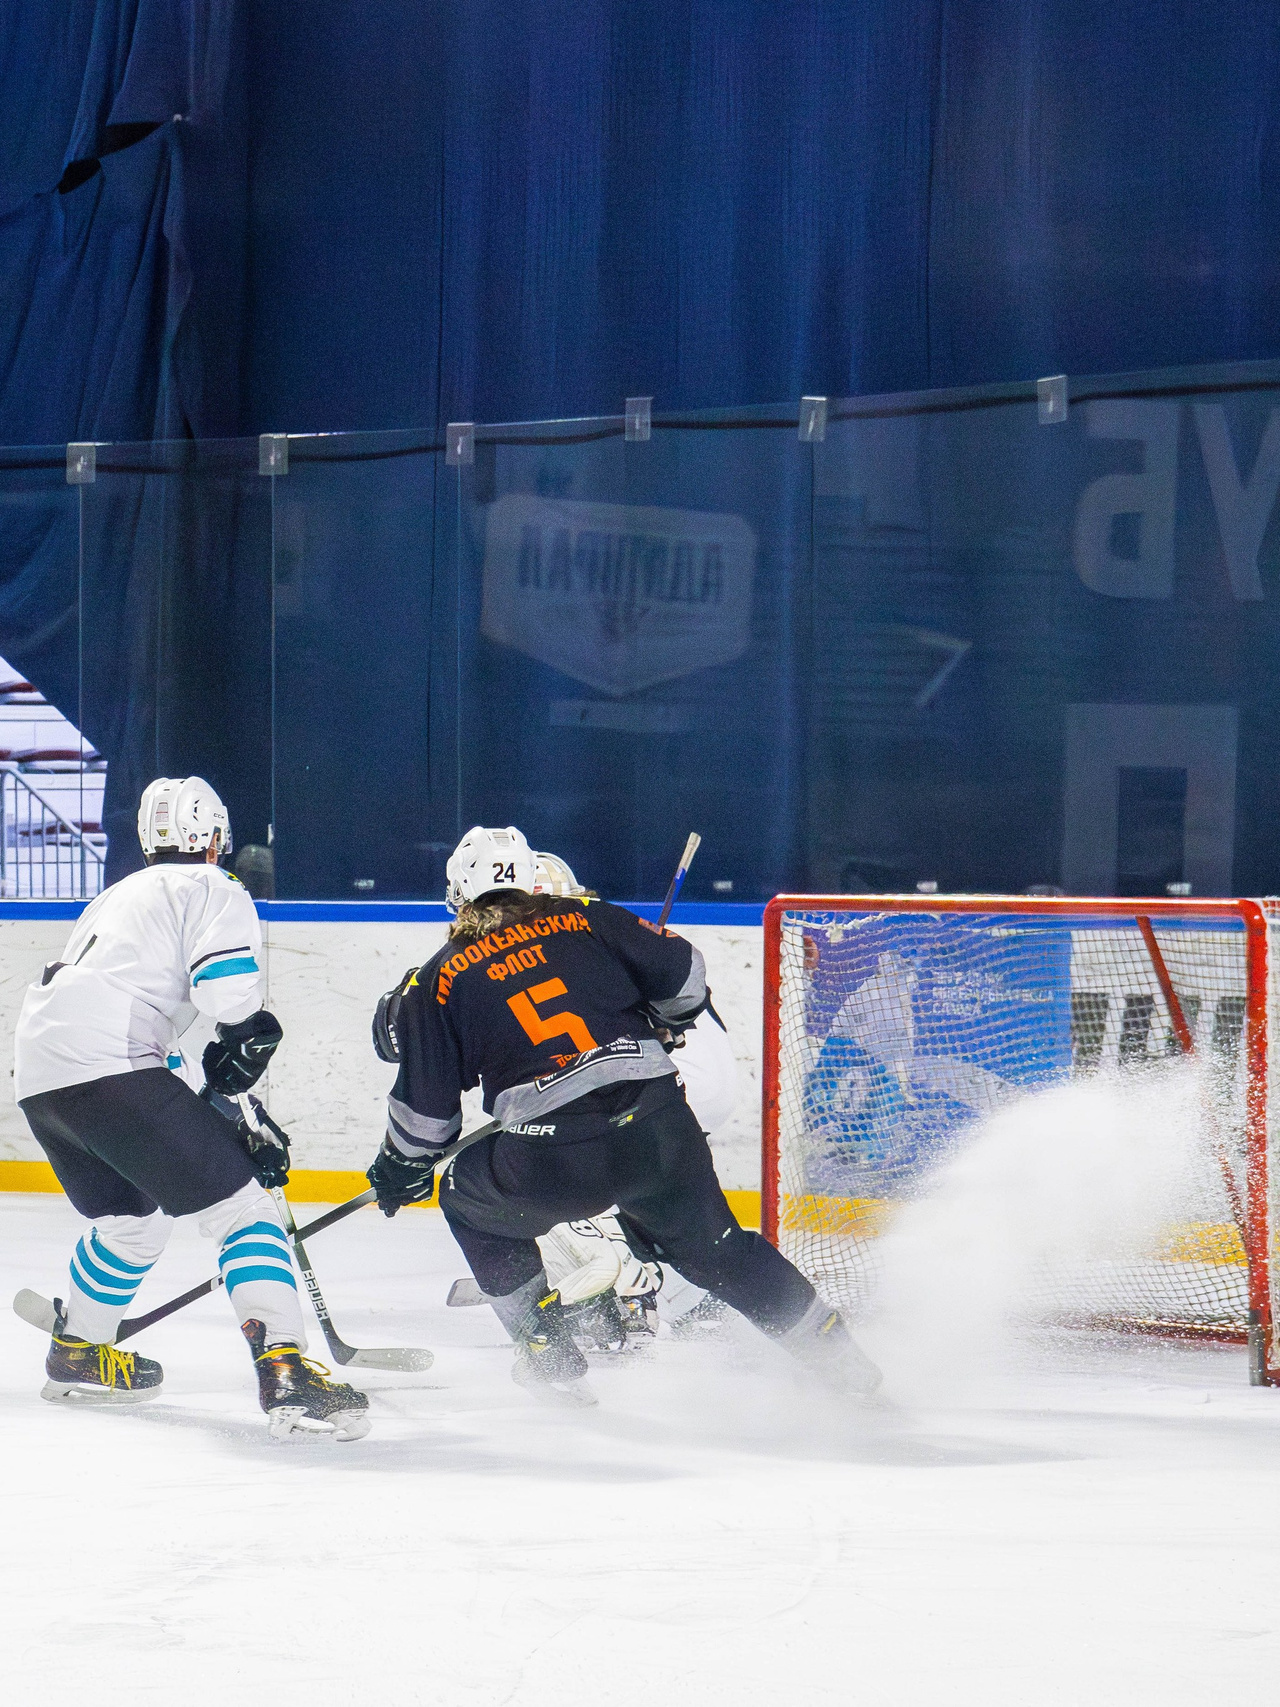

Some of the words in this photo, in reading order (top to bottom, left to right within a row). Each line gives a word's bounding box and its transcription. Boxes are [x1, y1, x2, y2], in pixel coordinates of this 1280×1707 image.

[492, 862, 516, 884] 24
[486, 944, 548, 982] ФЛОТ
[506, 976, 599, 1054] 5
[508, 1123, 557, 1136] AUER
[302, 1269, 330, 1321] BAUER
